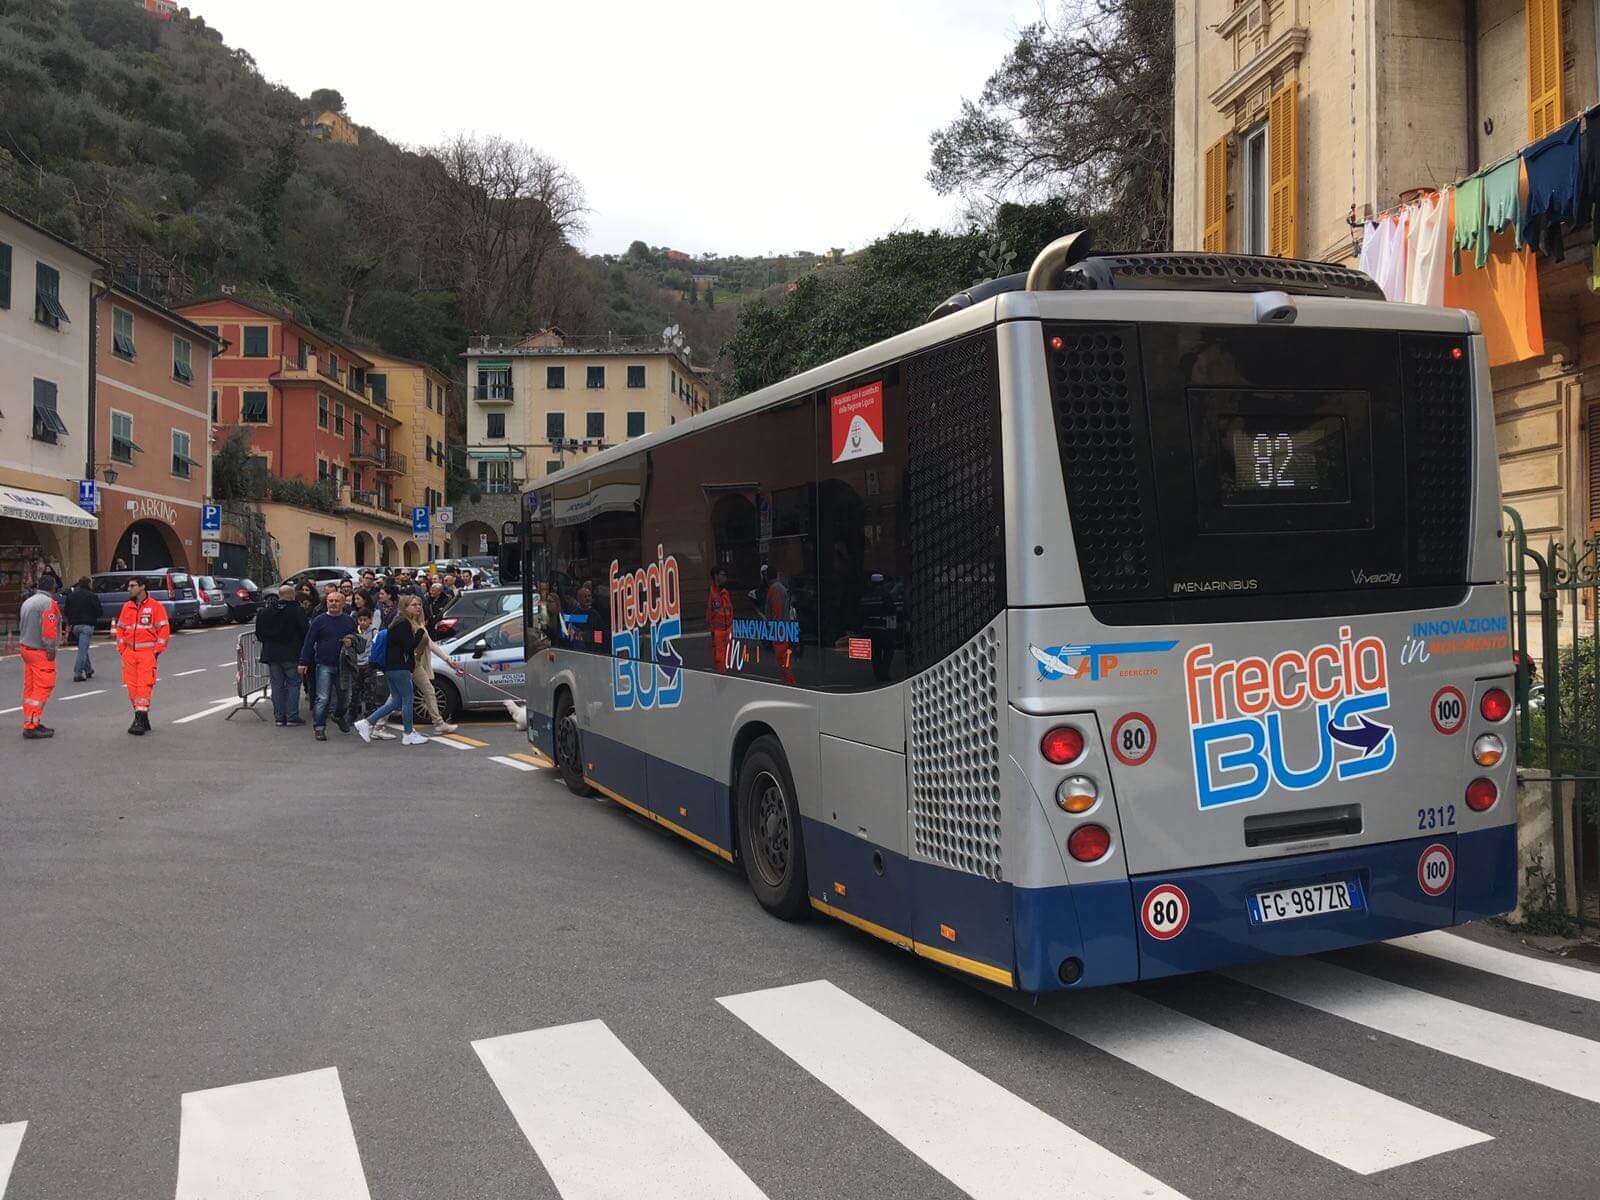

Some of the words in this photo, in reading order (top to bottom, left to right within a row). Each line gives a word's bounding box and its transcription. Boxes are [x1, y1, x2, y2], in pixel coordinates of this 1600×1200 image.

[1253, 432, 1295, 487] 82
[205, 506, 217, 519] P
[415, 508, 425, 520] P
[610, 543, 681, 634] freccia
[1176, 578, 1259, 593] MENARINIBUS
[1351, 568, 1402, 586] Vivacity
[732, 617, 800, 643] INNOVAZIONE
[1412, 614, 1507, 637] INNOVAZIONE
[1400, 635, 1431, 666] in
[611, 618, 684, 711] BUS
[1183, 625, 1388, 728] freccia
[1437, 699, 1461, 720] 100
[1123, 727, 1146, 750] 80
[1192, 692, 1397, 811] BUS
[1418, 804, 1457, 830] 2312
[1426, 859, 1447, 880] 100
[1152, 900, 1179, 926] 80
[1260, 893, 1287, 921] FG
[1291, 884, 1351, 915] 987ZR
